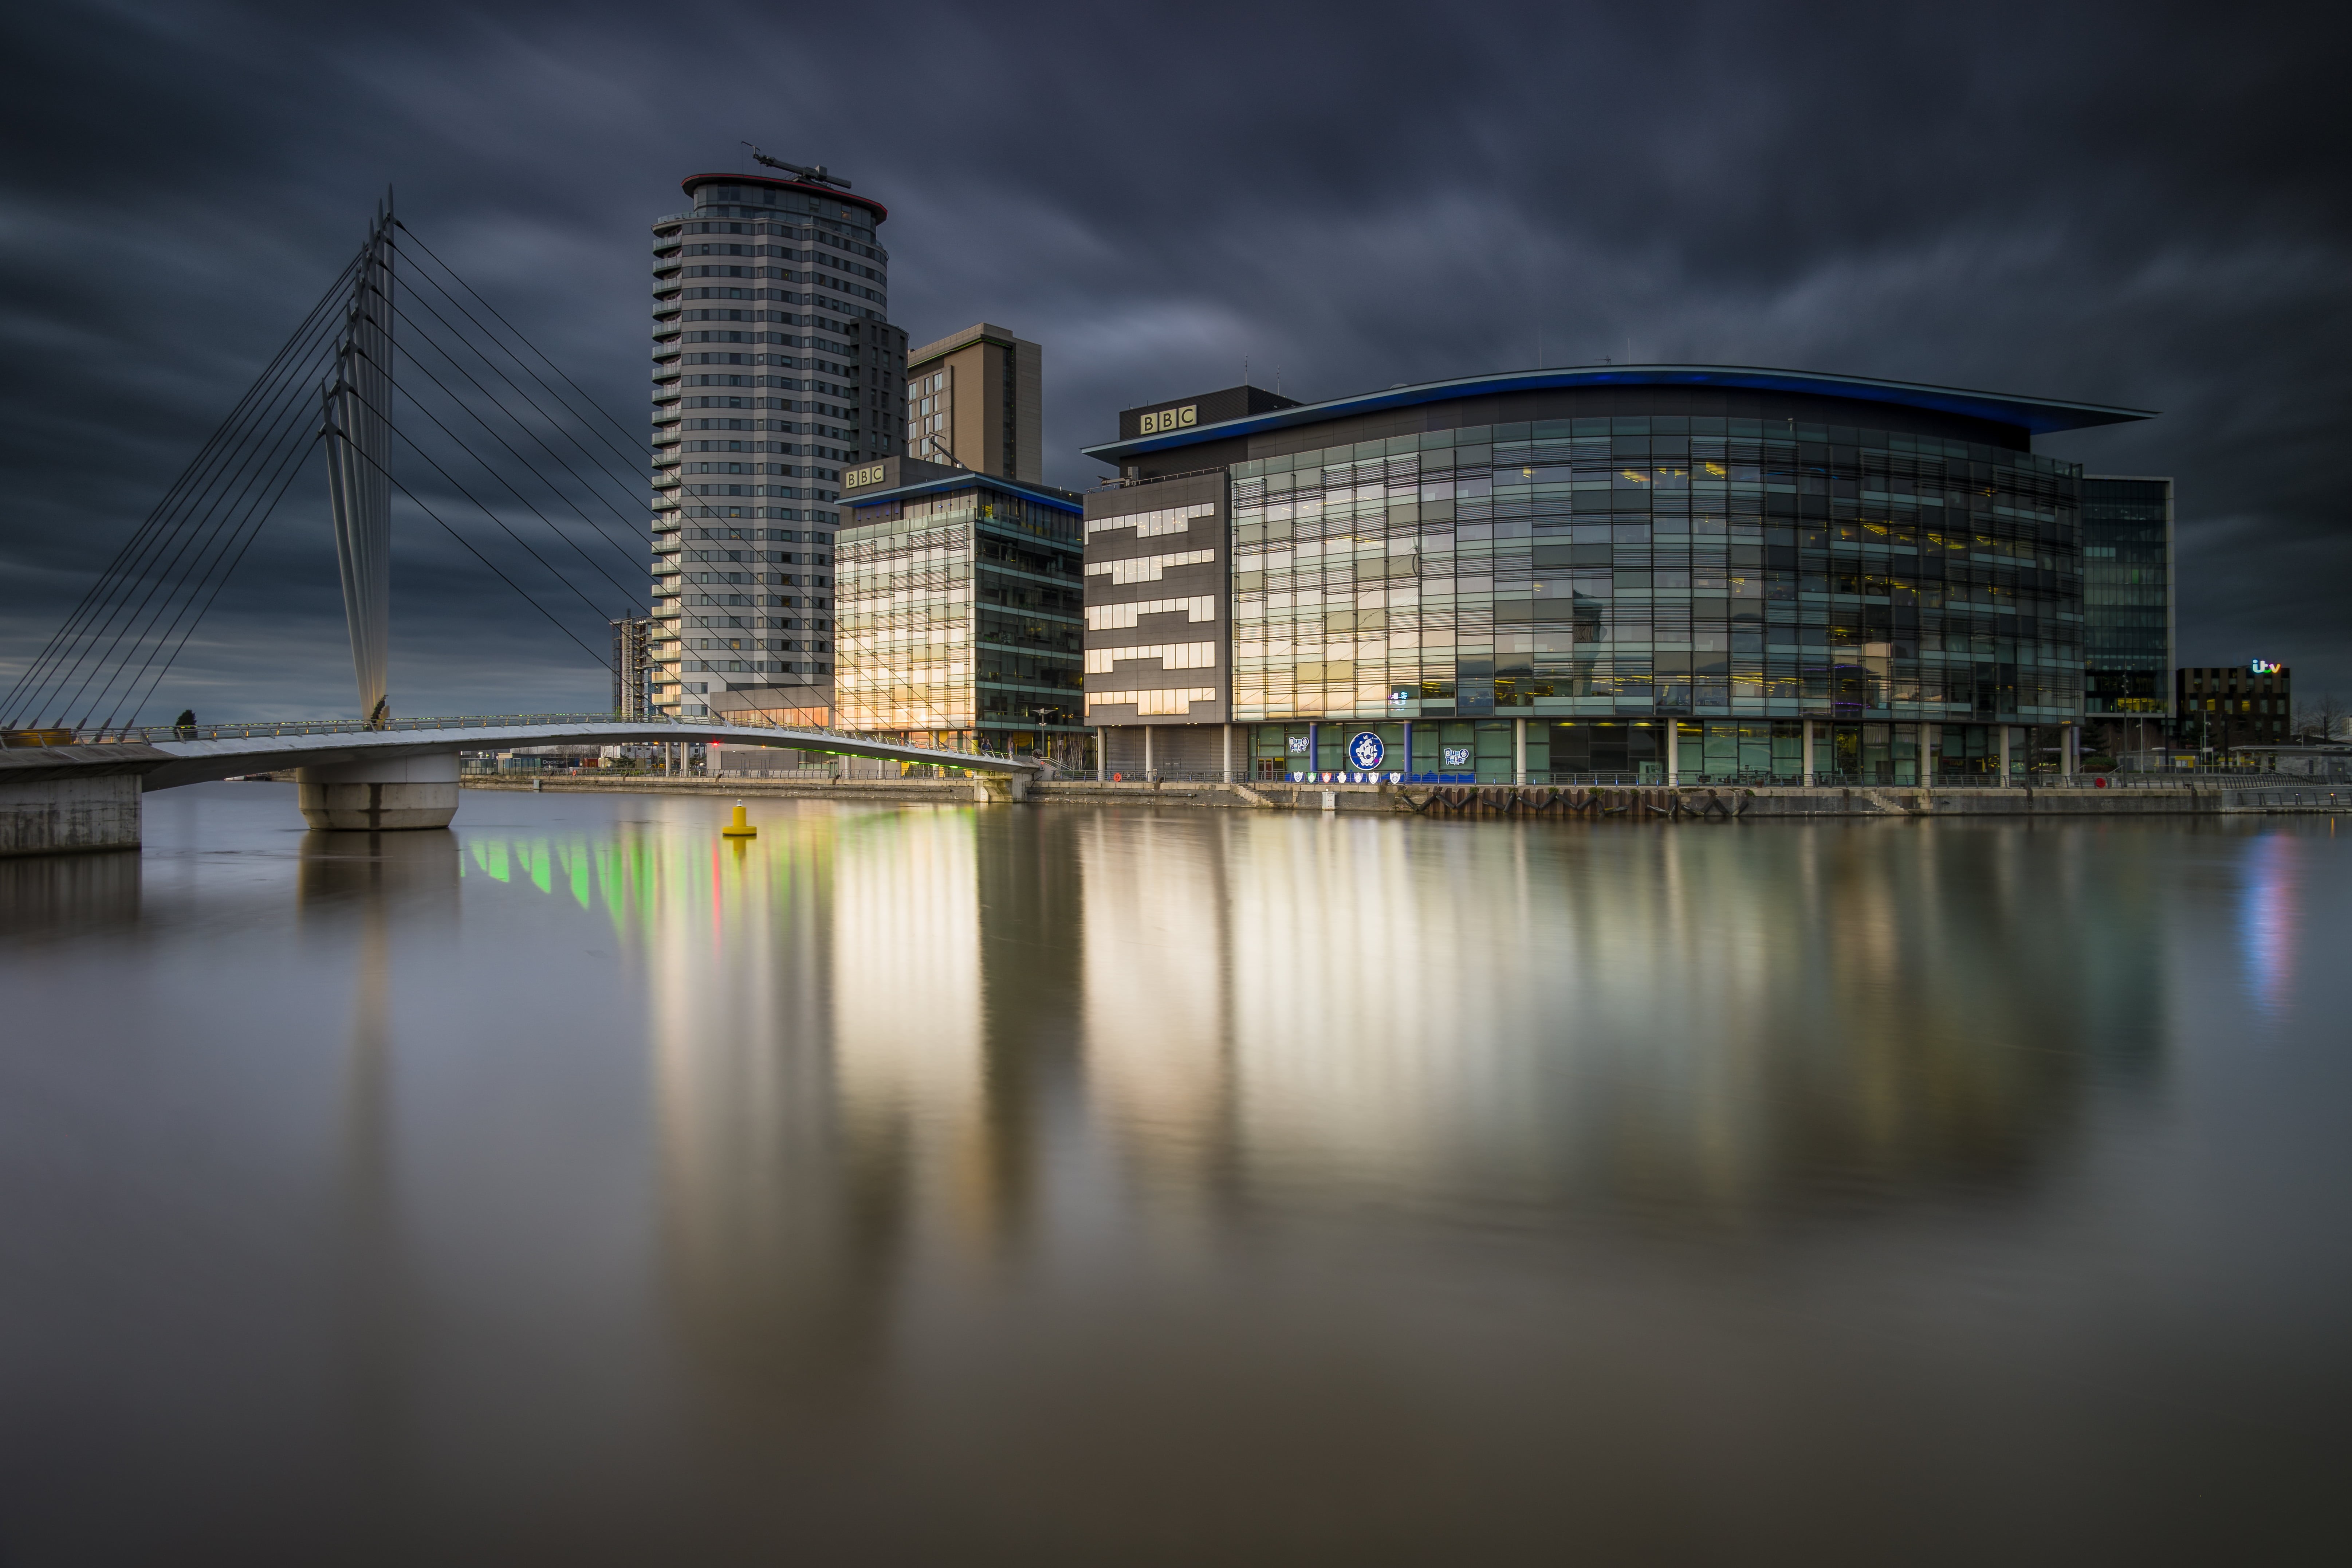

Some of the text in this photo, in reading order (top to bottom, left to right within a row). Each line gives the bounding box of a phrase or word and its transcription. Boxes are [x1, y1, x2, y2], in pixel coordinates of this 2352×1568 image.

[1144, 408, 1193, 431] BBC
[849, 468, 881, 486] BBC
[2253, 659, 2281, 673] itv
[1445, 749, 1459, 758] Blue
